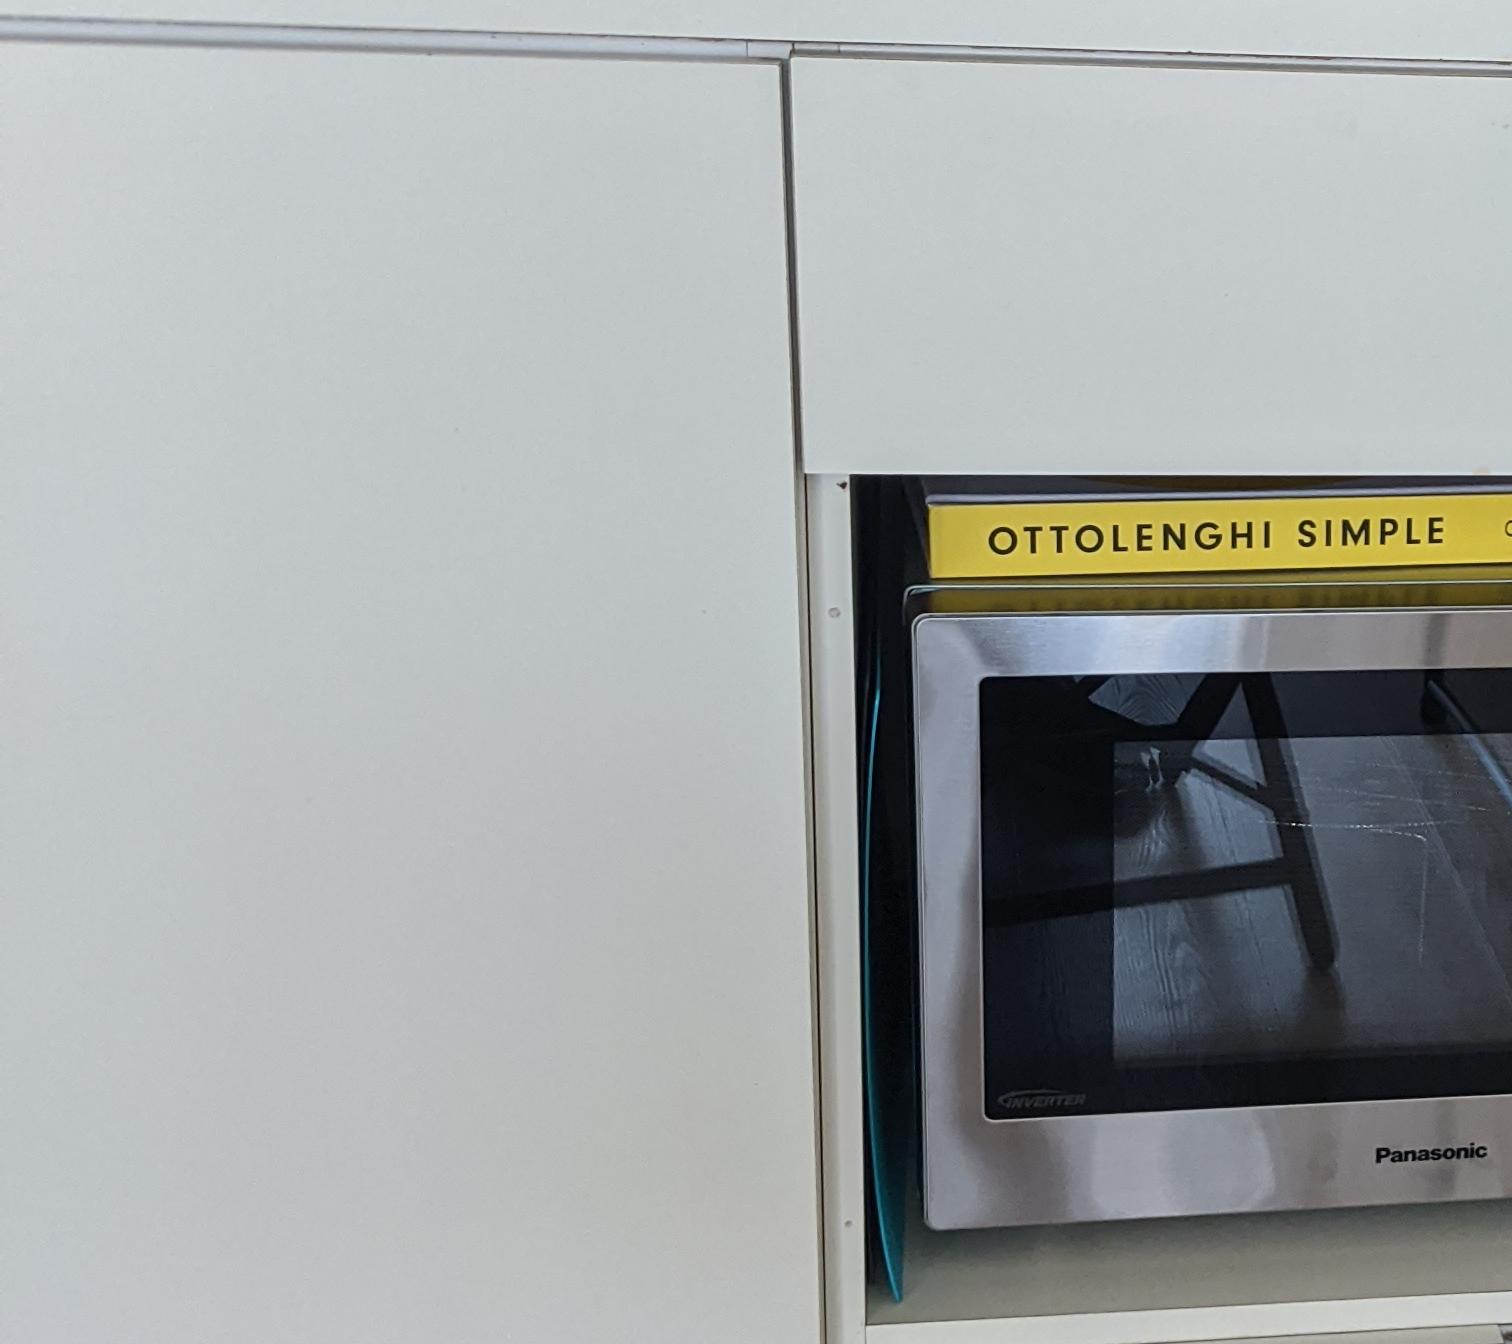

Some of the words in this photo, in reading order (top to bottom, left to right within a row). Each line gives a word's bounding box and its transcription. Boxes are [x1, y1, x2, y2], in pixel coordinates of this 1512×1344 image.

[987, 520, 1272, 556] OTTOLENGHI
[1297, 516, 1446, 548] SIMPLE
[1005, 1093, 1087, 1110] INVERTER
[1375, 1141, 1489, 1164] Panasonic
